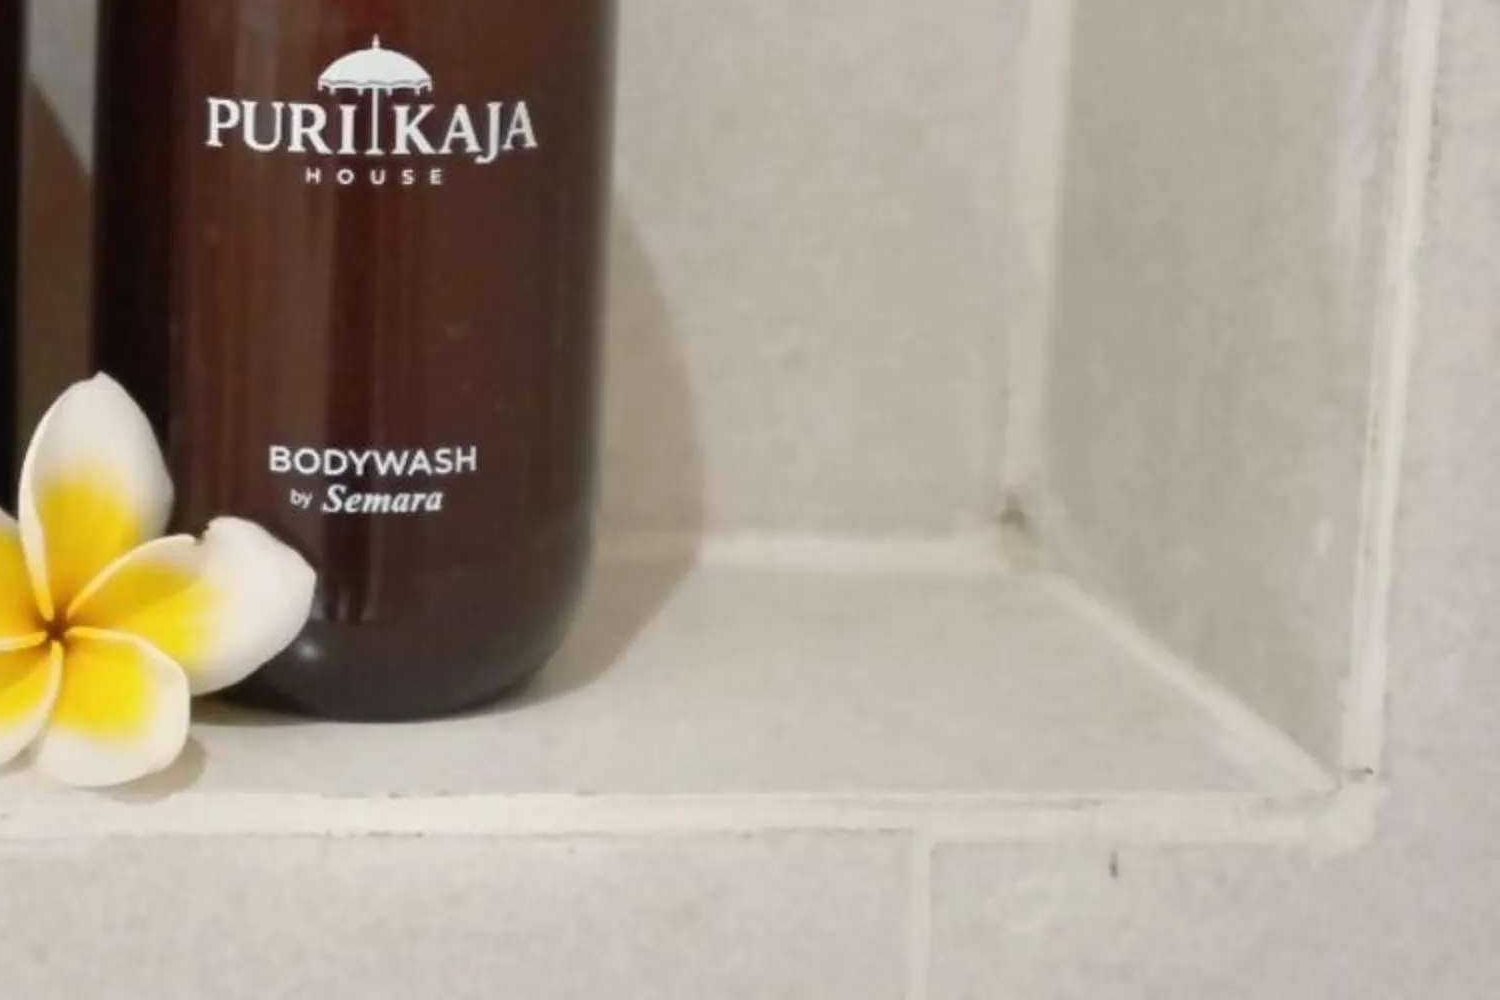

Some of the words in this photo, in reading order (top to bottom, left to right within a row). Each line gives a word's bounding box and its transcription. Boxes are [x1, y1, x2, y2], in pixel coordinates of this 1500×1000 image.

[205, 96, 357, 155] PURI
[391, 100, 538, 165] KAJA
[305, 167, 443, 185] HOUSE
[268, 445, 477, 476] BODYWASH
[289, 488, 313, 509] by
[320, 483, 444, 514] Semara
